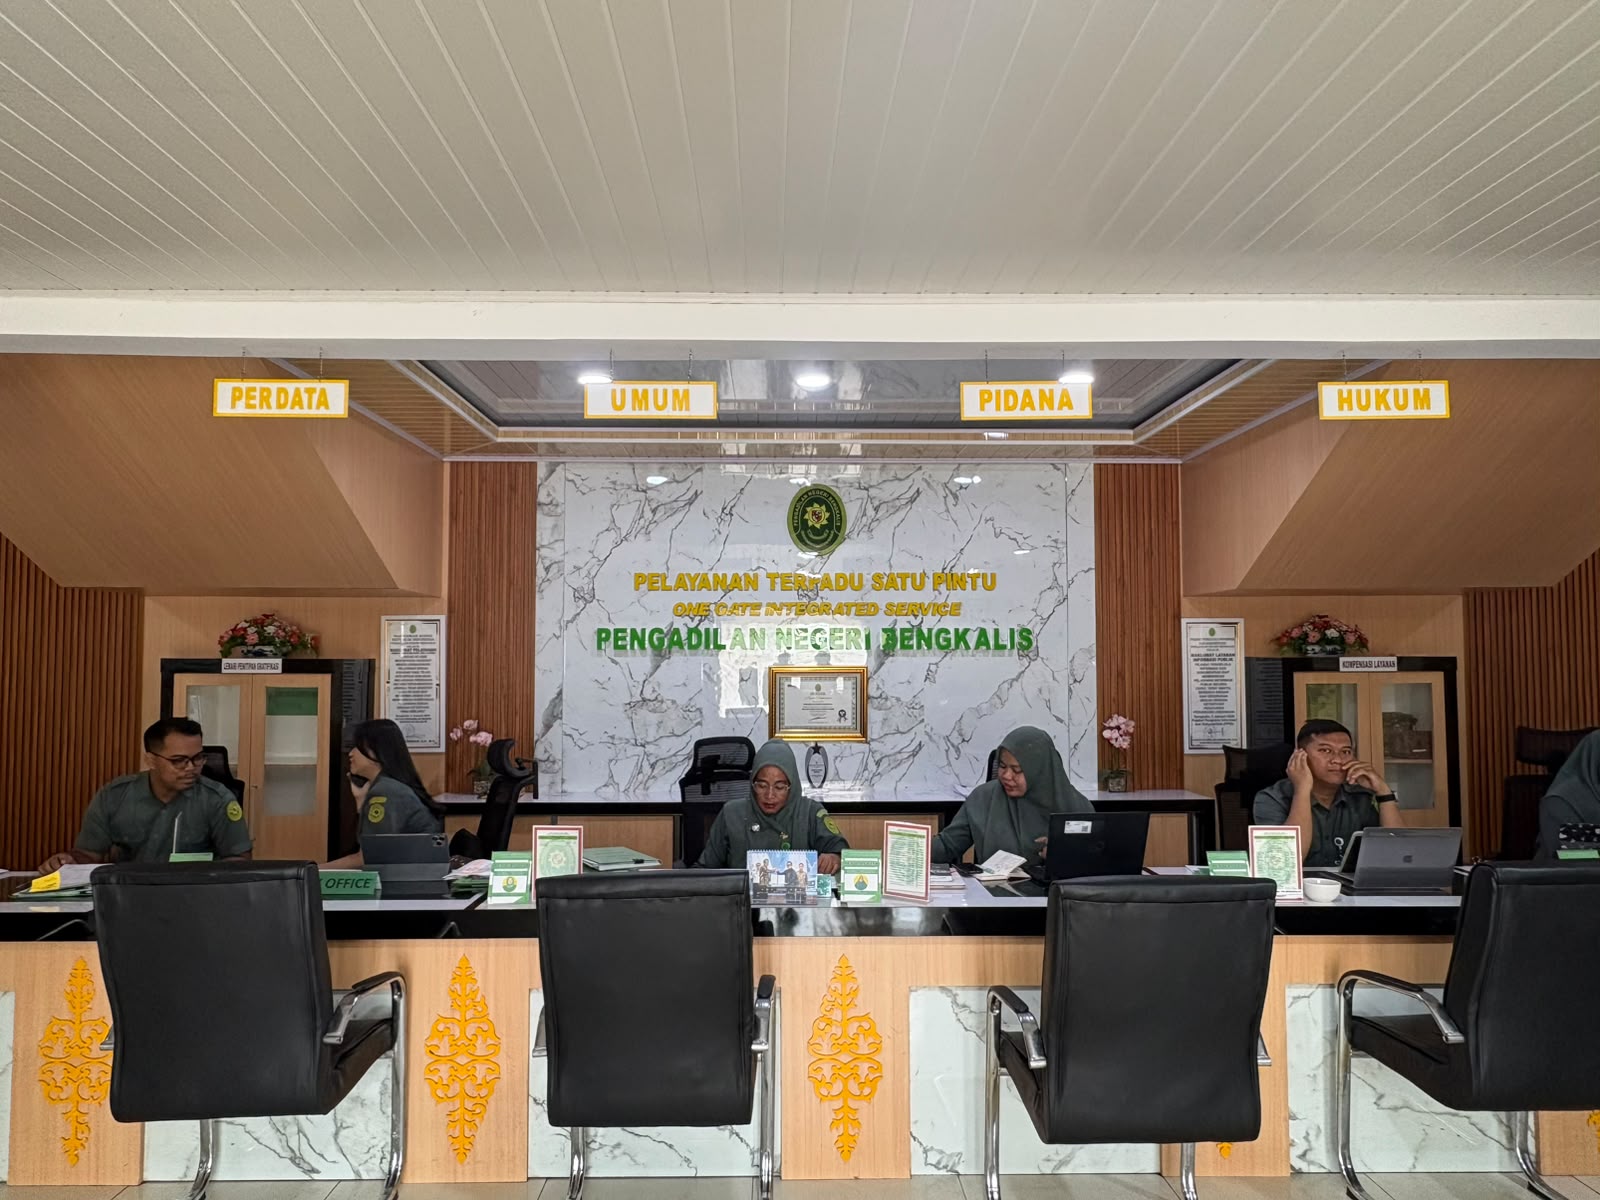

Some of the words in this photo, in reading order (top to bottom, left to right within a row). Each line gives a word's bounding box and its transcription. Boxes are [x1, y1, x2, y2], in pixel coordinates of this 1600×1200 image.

[230, 386, 330, 411] PERDATA
[611, 388, 691, 412] UMUM
[979, 388, 1074, 412] PIDANA
[1337, 387, 1431, 412] HUKUM
[633, 572, 759, 592] PELAYANAN
[766, 572, 864, 592] TERPADU
[871, 572, 926, 592] SATU
[932, 572, 997, 592] PINTU
[673, 602, 711, 617] ONE
[714, 602, 762, 617] GATE
[765, 602, 880, 617] INTEGRATED
[884, 602, 962, 617] SERVICE
[596, 627, 767, 651] PENGADILAN
[775, 627, 872, 651] NEGERI
[881, 627, 1034, 652] BENGKALIS
[324, 878, 371, 889] OFFICE
